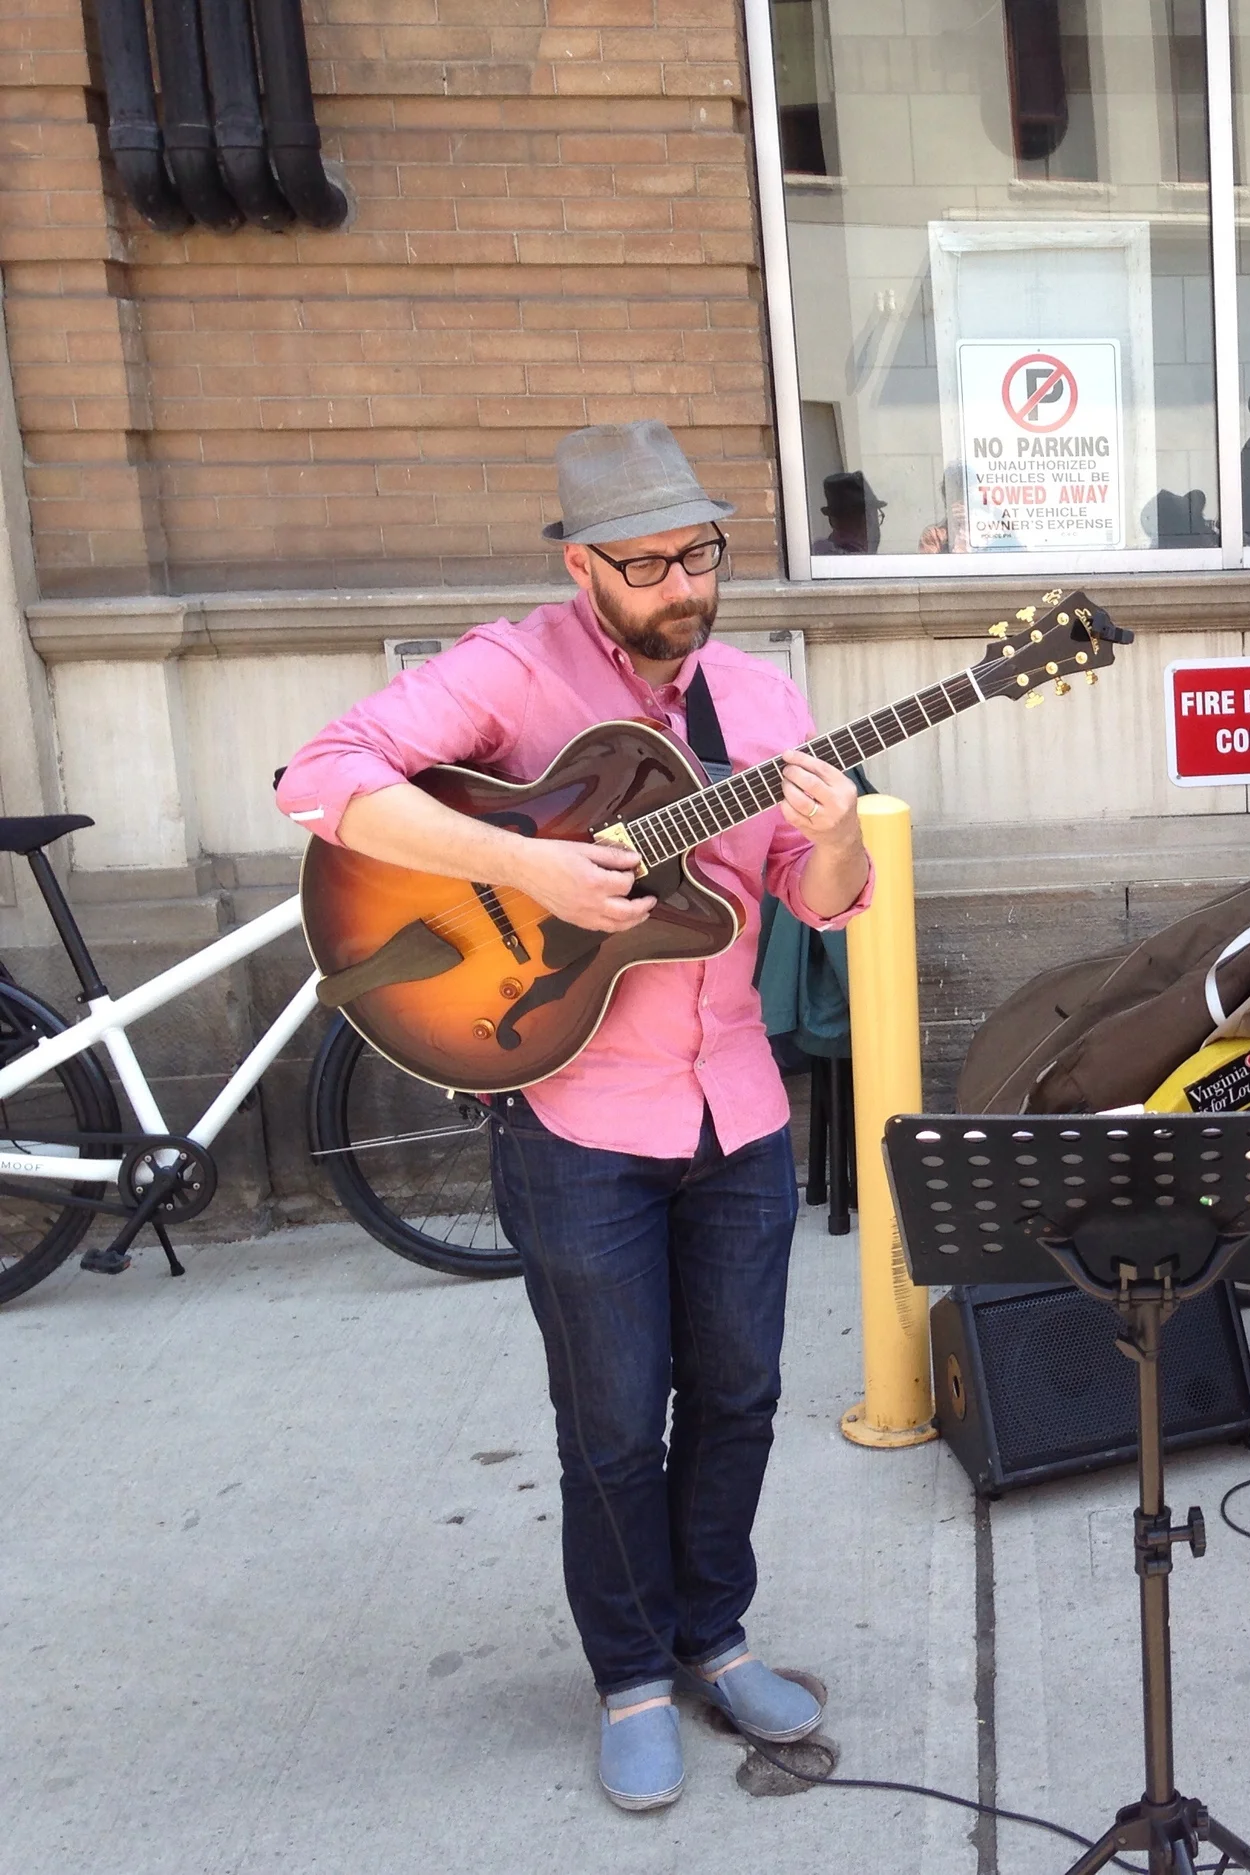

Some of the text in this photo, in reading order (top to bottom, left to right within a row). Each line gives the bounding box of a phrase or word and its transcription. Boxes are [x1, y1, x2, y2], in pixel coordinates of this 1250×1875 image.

[973, 436, 1110, 458] NO PARKING
[988, 459, 1097, 471] UNAUTHORIZED
[976, 472, 1110, 484] VEHICLES WILL BE
[978, 484, 1108, 505] TOWED AWAY
[1001, 507, 1088, 518] AT VEHICLE
[976, 518, 1113, 532] OWNER'S EXPENSE
[1180, 690, 1235, 716] FIRE
[1188, 1066, 1250, 1103] Virginia
[1208, 1096, 1228, 1113] for
[1, 1161, 44, 1171] MOOF
